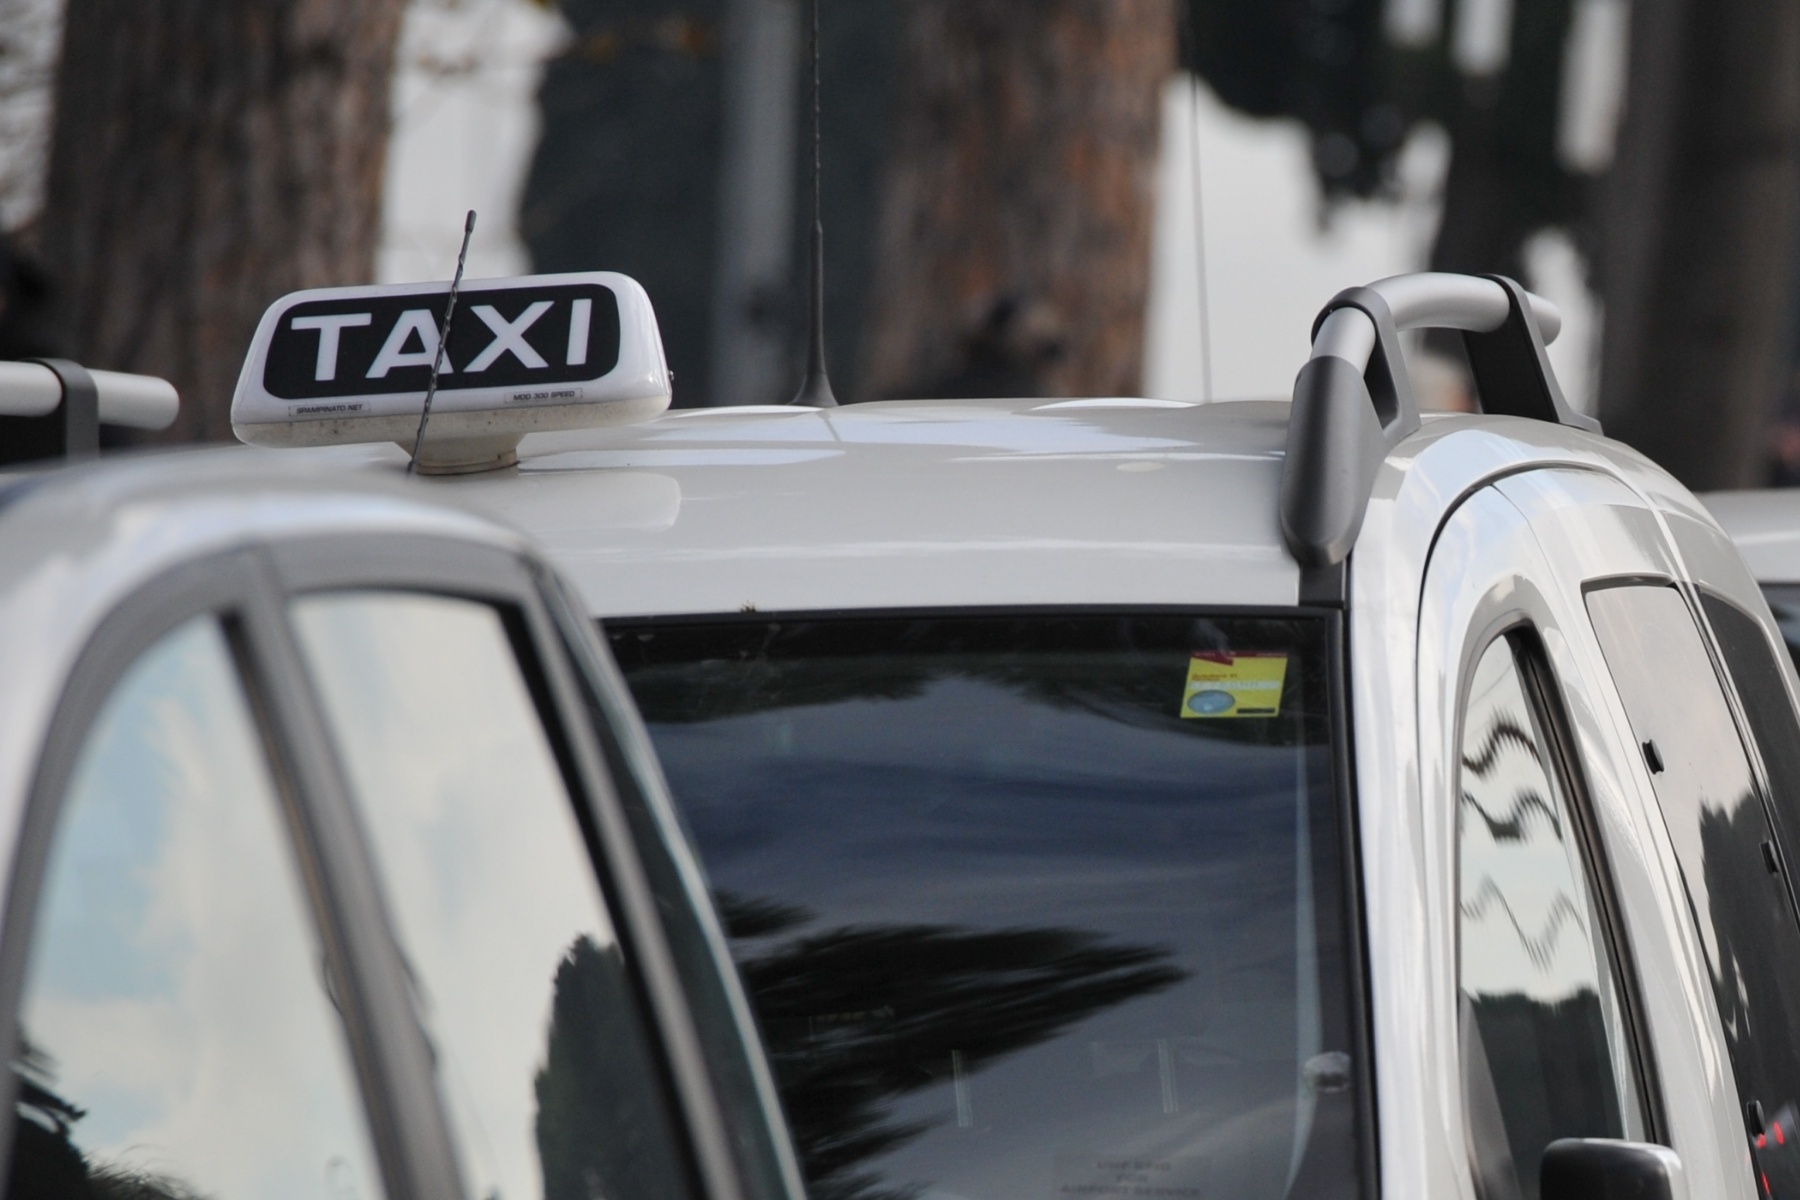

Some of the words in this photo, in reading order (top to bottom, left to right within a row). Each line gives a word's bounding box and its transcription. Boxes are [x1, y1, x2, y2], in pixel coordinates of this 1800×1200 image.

[290, 298, 593, 381] TAXI
[534, 391, 549, 399] 300
[550, 390, 575, 398] SPEED
